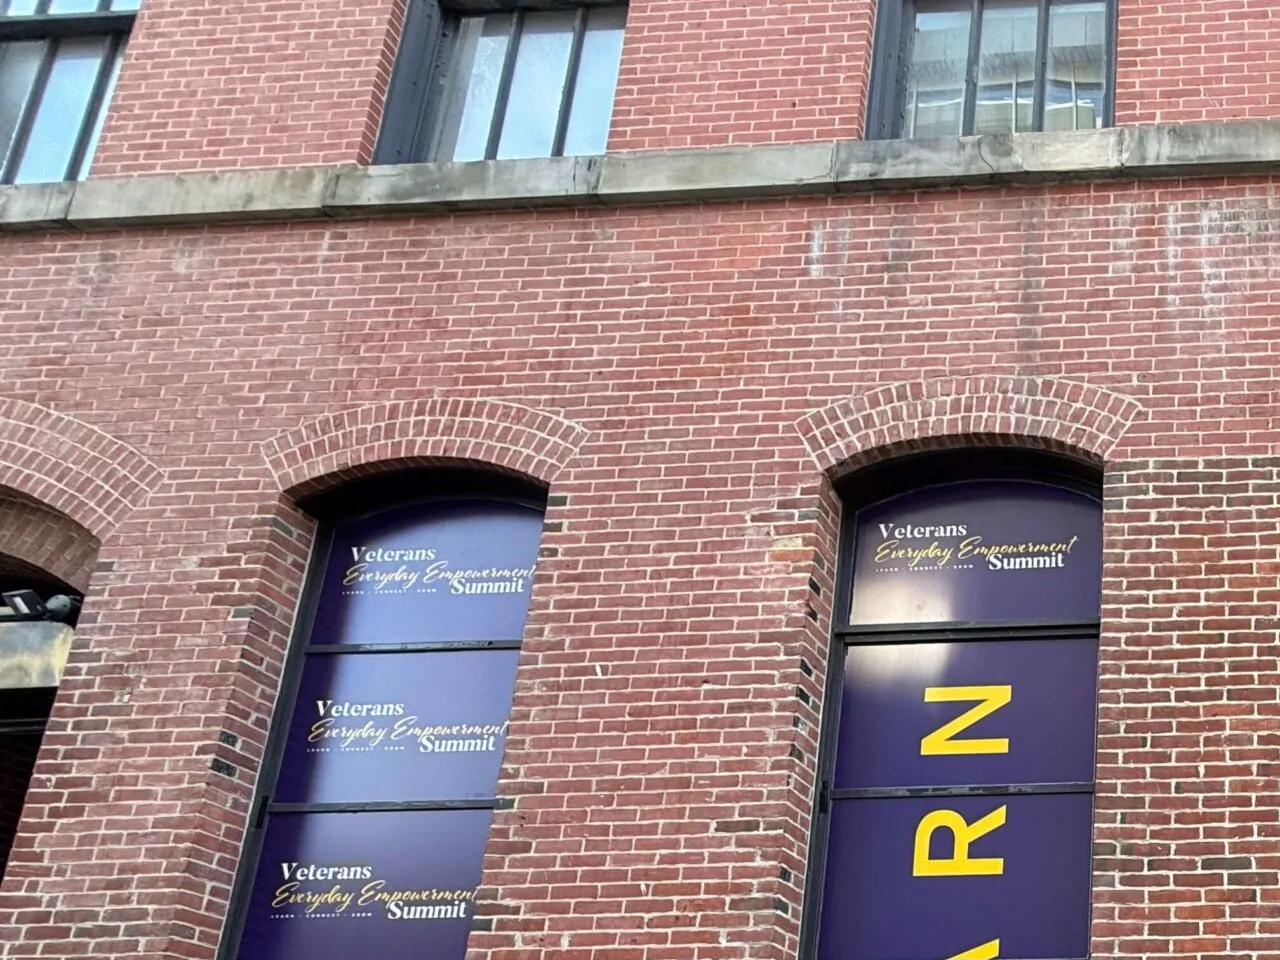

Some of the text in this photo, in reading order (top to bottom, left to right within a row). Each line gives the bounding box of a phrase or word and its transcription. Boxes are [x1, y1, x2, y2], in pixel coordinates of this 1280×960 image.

[878, 523, 968, 539] Veterans
[351, 546, 436, 562] Veterans
[874, 535, 1079, 567] Everyday Empowerment
[988, 552, 1065, 571] Summit
[343, 562, 421, 589] Everyday
[450, 577, 525, 595] Summit
[316, 700, 405, 717] Veterans
[308, 717, 388, 747] Everyday
[419, 735, 496, 753] Summit
[281, 862, 372, 880] Veterans
[271, 881, 355, 913] Everyday
[387, 900, 467, 920] Summit
